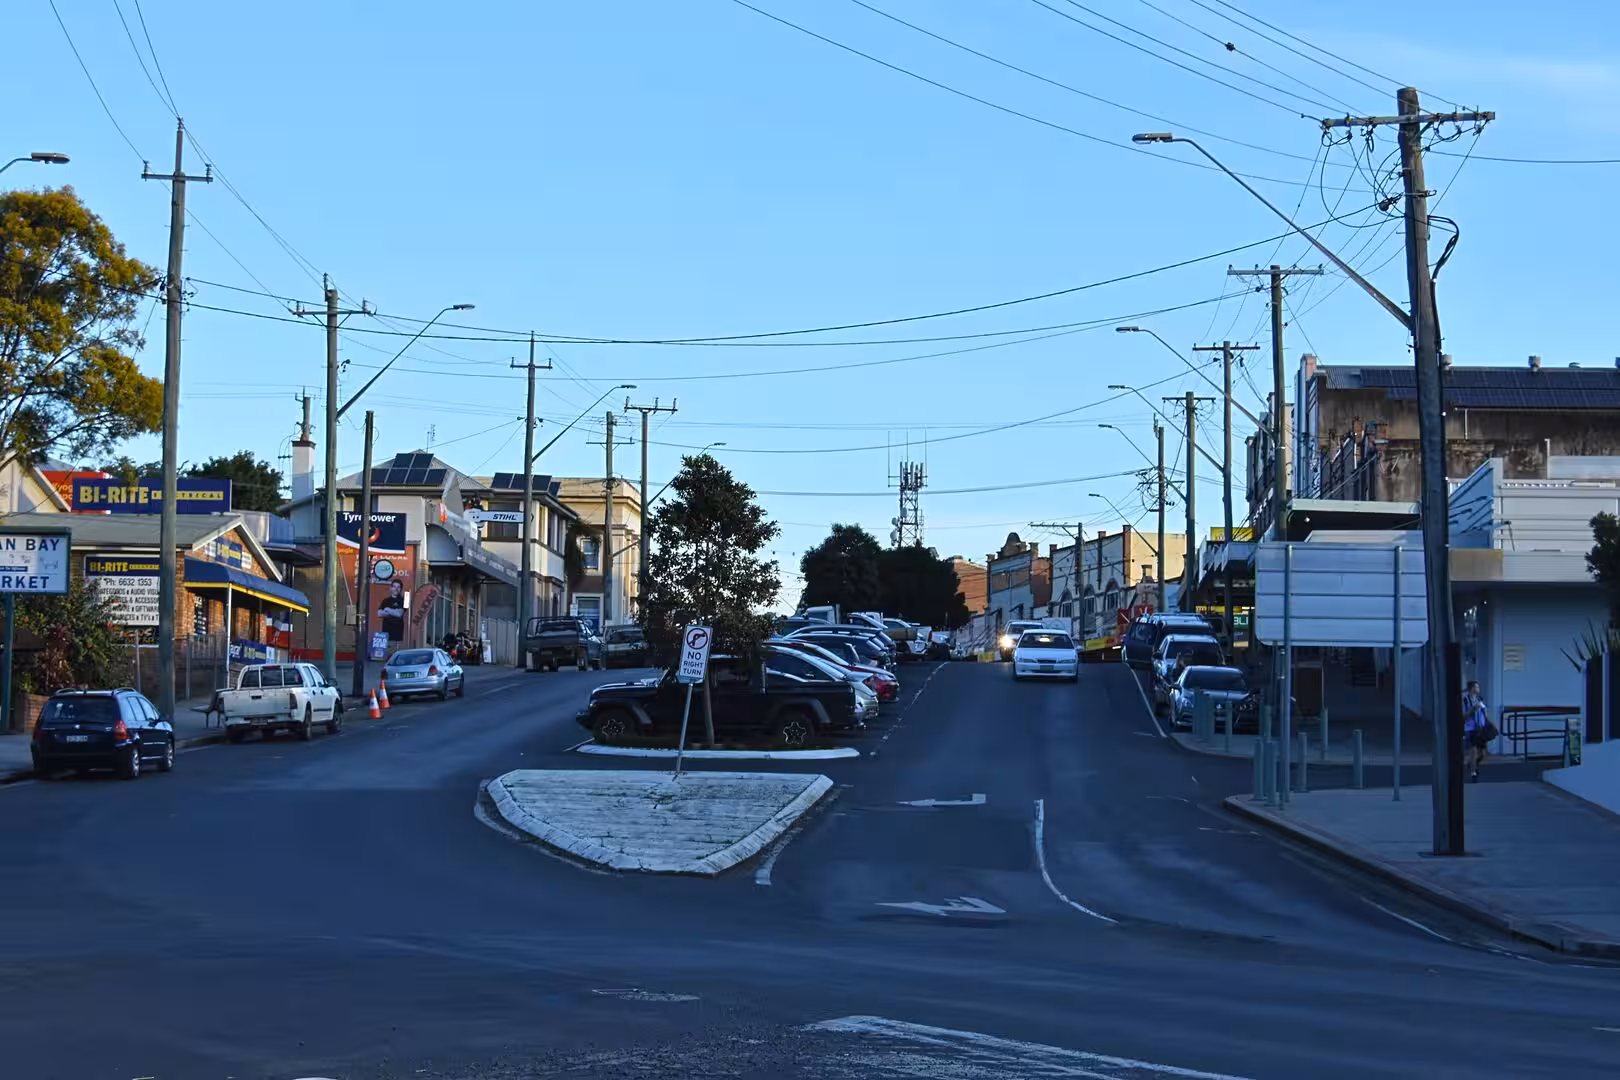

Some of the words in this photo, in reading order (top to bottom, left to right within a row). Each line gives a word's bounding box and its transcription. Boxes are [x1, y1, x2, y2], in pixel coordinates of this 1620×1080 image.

[79, 485, 149, 504] BI-RITE
[493, 513, 517, 521] STIHL
[26, 538, 60, 551] BAY
[90, 561, 129, 573] BI-RITE
[137, 578, 152, 587] 1353
[687, 651, 702, 660] NO
[683, 660, 704, 669] RIGHT
[683, 668, 702, 676] TURN
